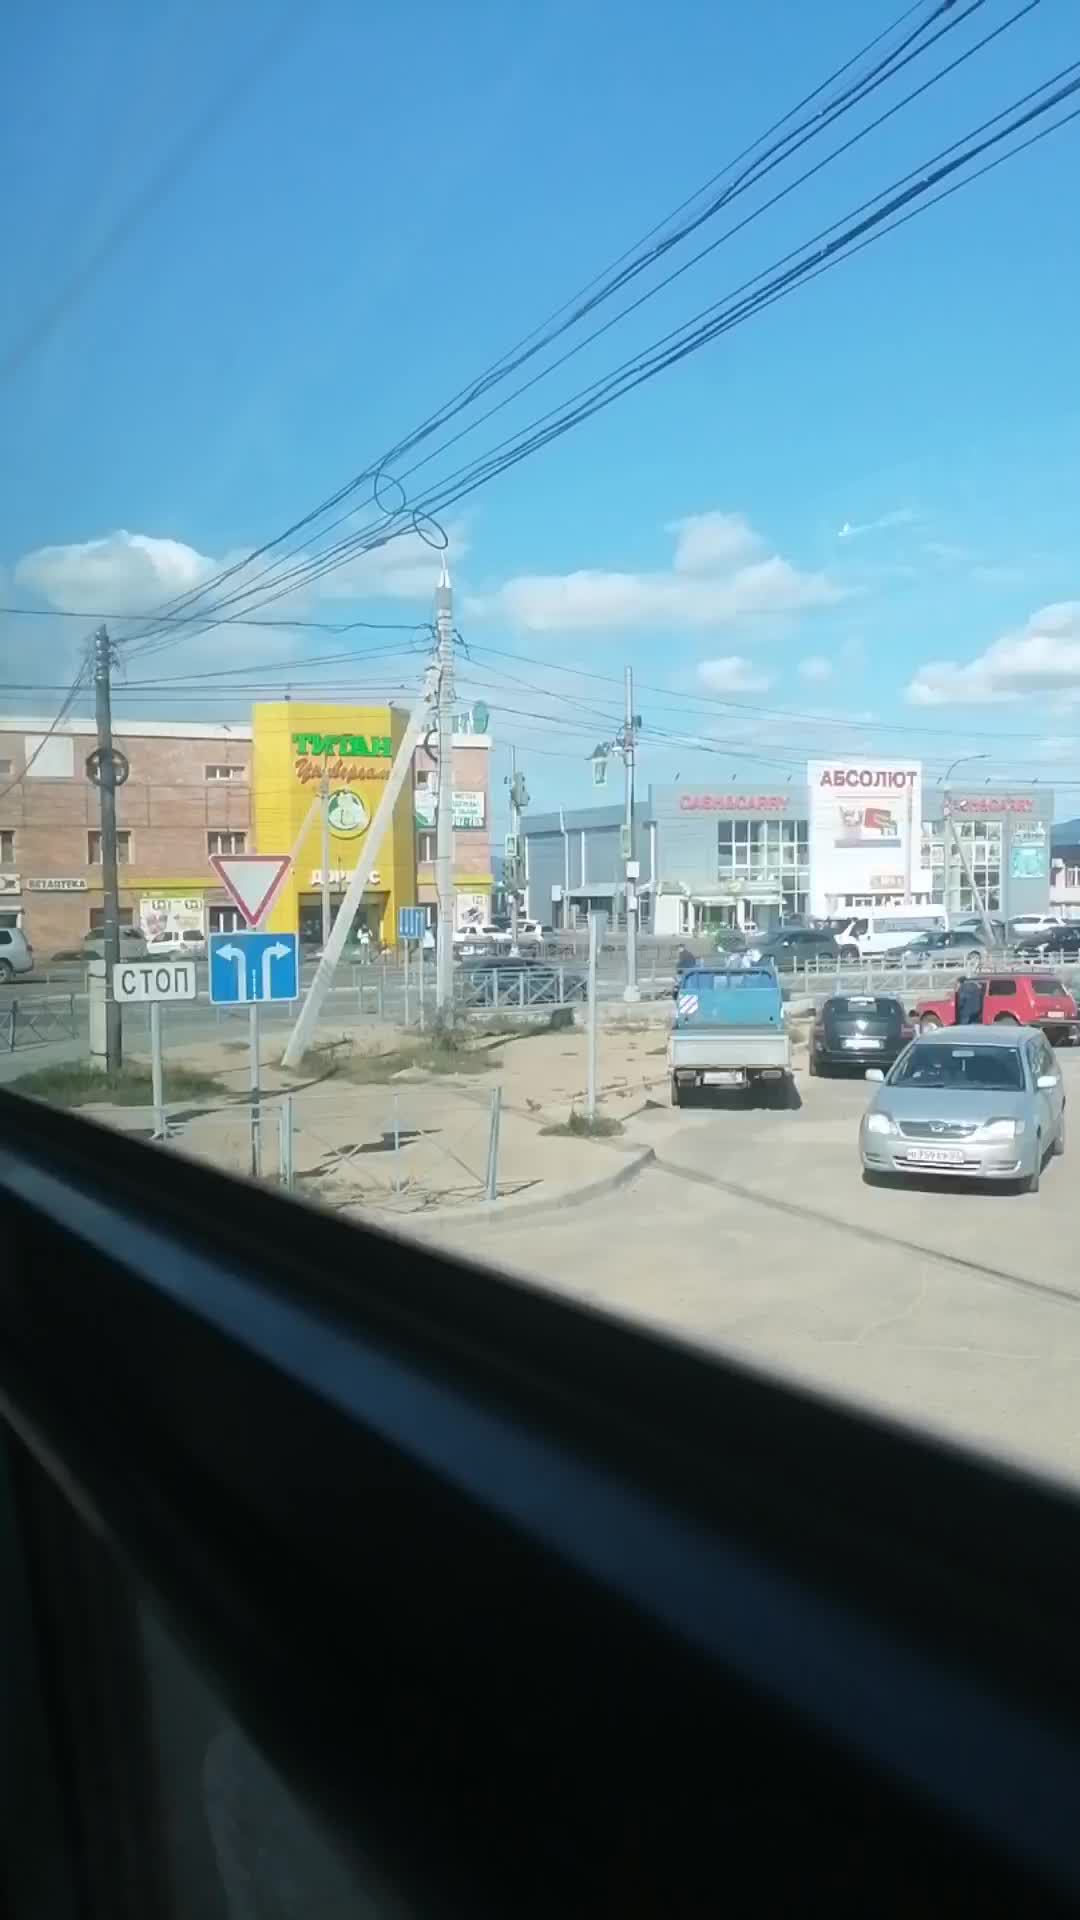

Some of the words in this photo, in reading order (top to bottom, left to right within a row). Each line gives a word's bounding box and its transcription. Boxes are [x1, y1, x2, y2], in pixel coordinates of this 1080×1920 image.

[291, 733, 391, 757] ТИТАН
[820, 770, 917, 788] АБСОЛЮТ
[122, 967, 188, 995] СТОП
